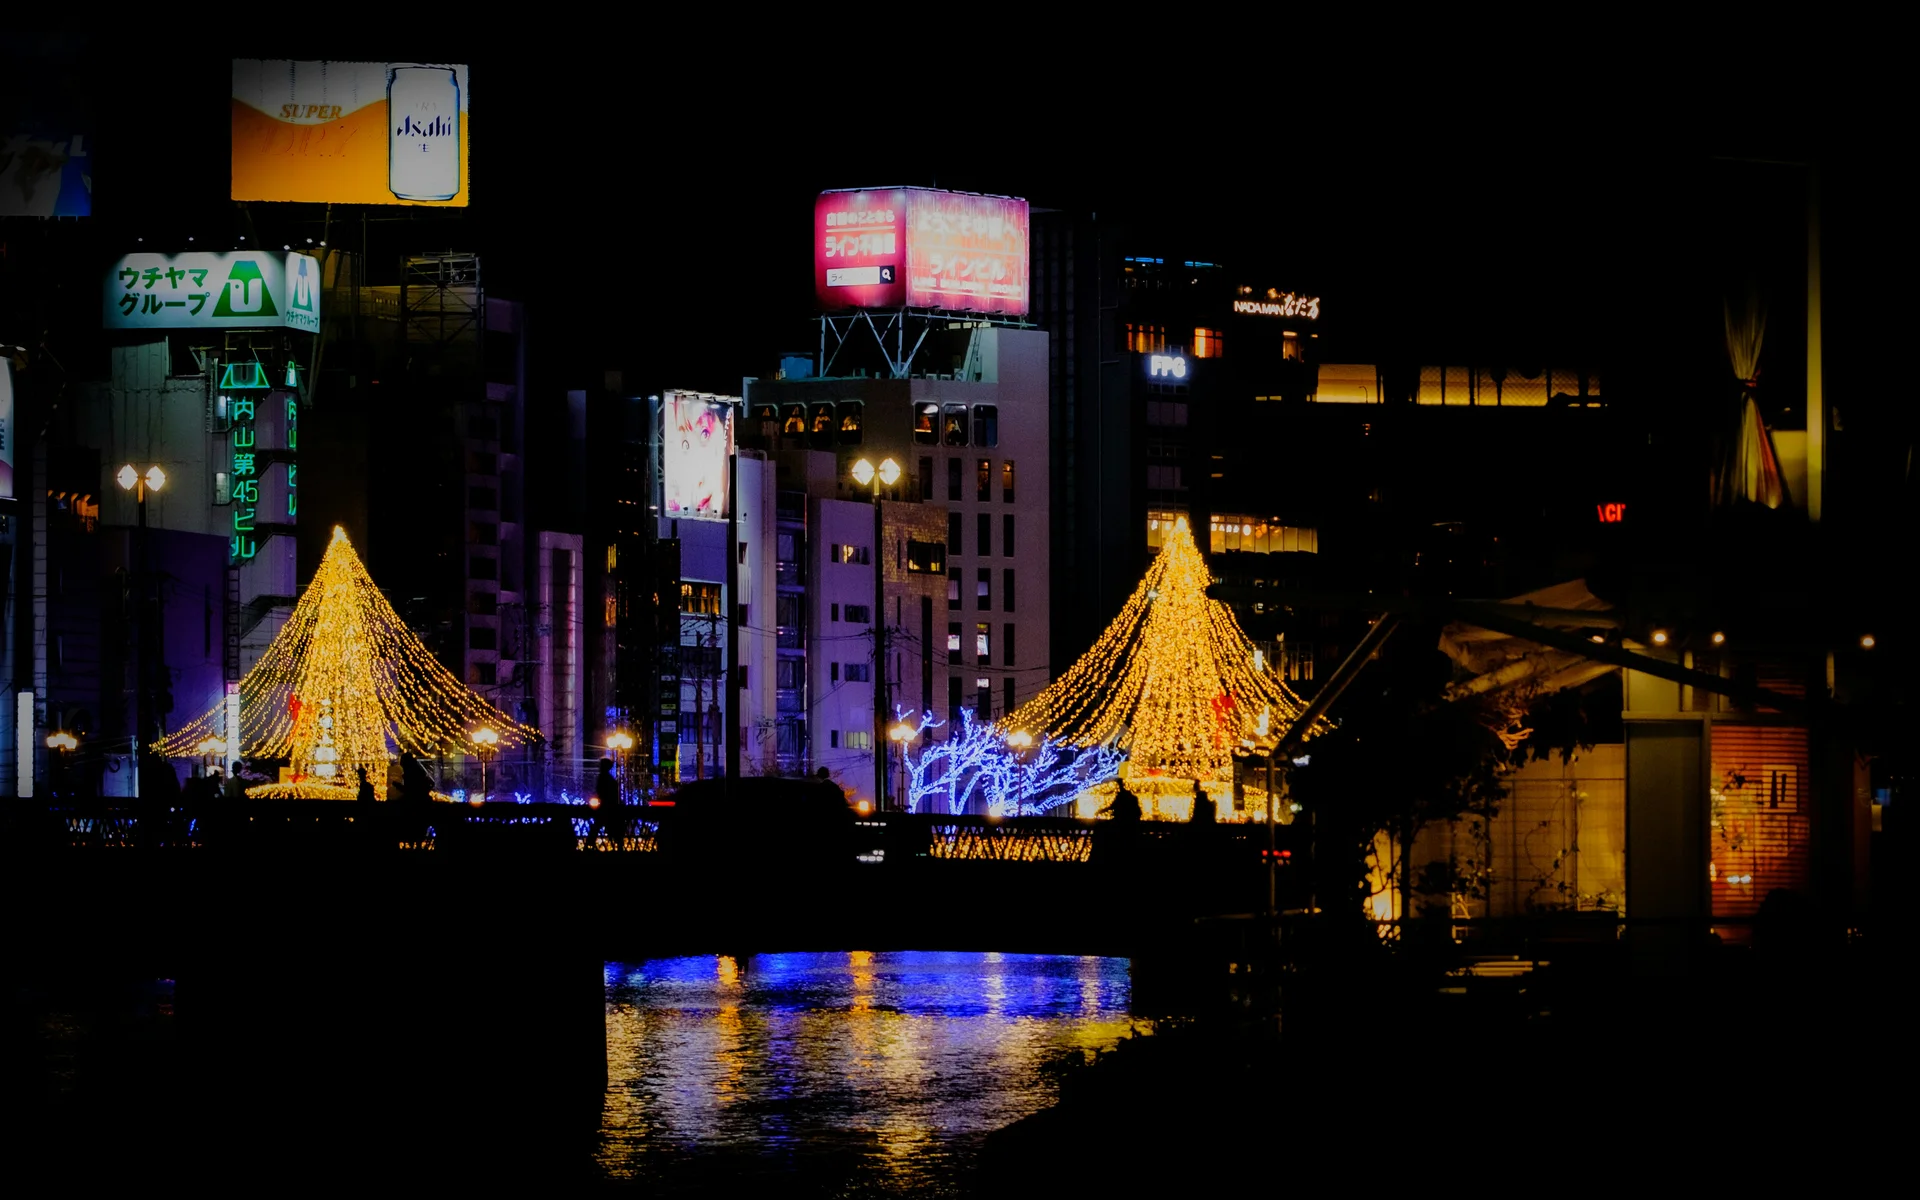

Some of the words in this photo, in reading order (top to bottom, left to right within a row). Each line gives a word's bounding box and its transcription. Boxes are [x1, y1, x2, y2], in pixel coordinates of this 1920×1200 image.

[280, 104, 342, 119] SUPER
[396, 115, 451, 137] Asahi
[119, 266, 208, 290] ウチヤマ
[119, 292, 210, 316] グループ
[1234, 301, 1284, 315] NADAMAN
[1151, 355, 1186, 377] FPG
